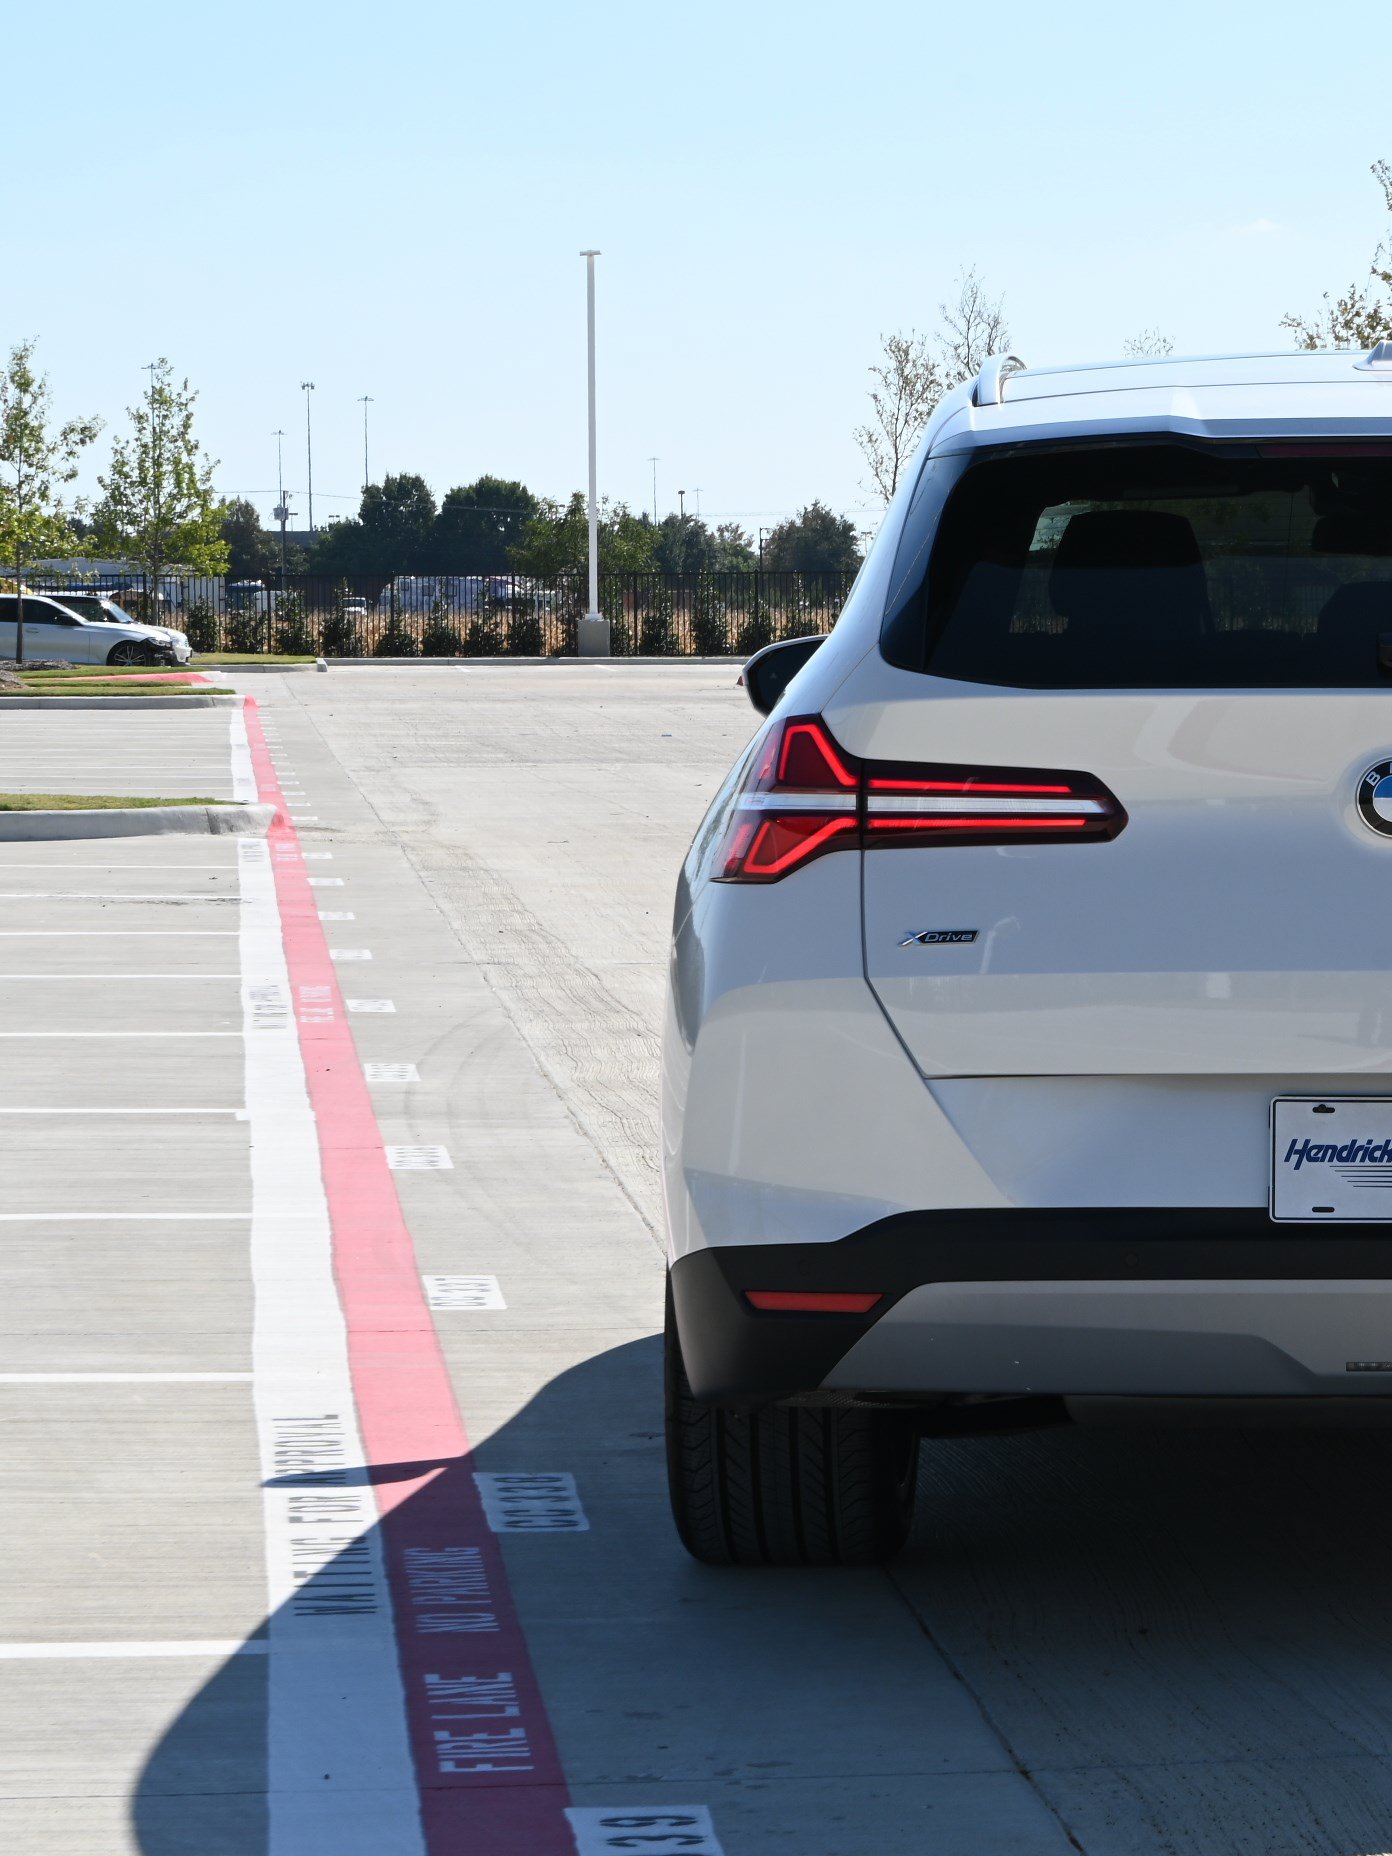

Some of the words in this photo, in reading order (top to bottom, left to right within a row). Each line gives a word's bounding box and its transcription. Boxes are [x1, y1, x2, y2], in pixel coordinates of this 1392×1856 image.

[271, 1414, 346, 1485] APPROVAL
[288, 1495, 364, 1523] FOR
[290, 1537, 378, 1616] WAITING
[403, 1547, 492, 1605] PARKING
[415, 1612, 500, 1633] NO
[423, 1672, 520, 1719] LANE
[433, 1727, 535, 1773] FIRE
[599, 1815, 708, 1856] 39
